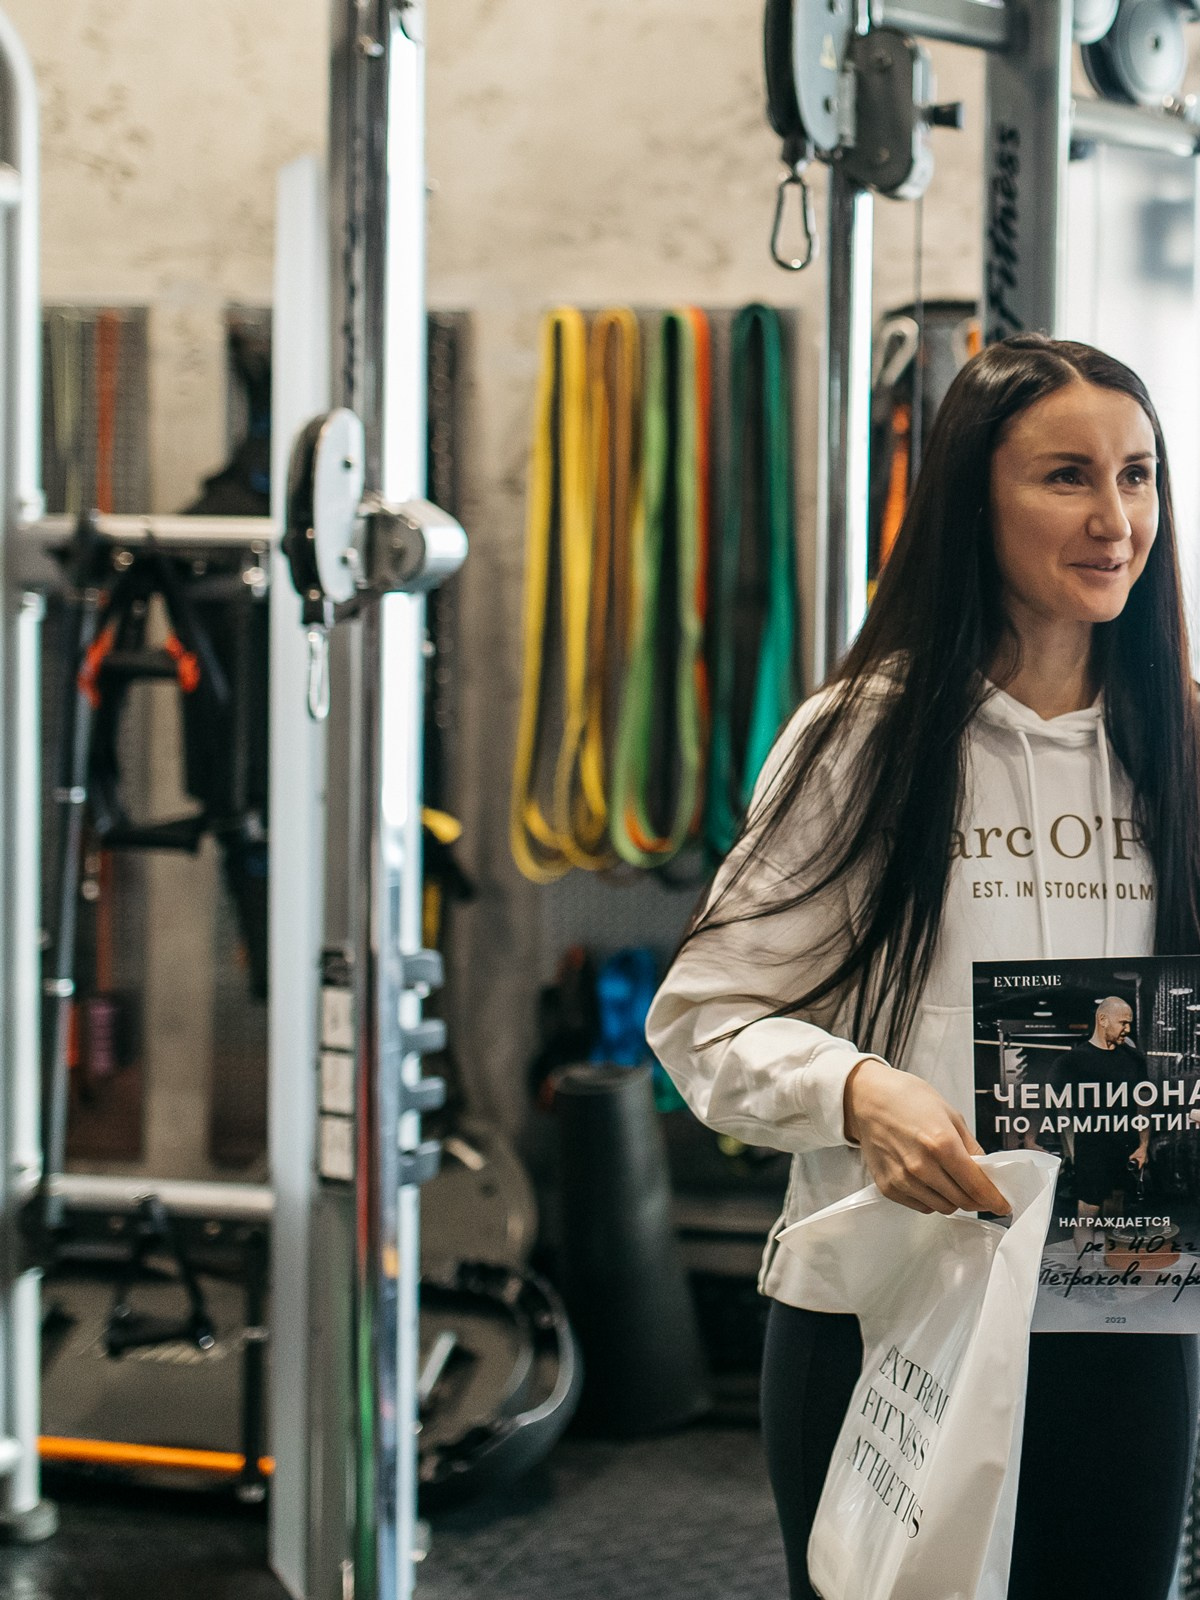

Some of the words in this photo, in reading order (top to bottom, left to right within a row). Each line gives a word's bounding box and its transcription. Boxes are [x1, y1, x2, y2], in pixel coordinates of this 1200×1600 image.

[948, 826, 1034, 860] arc
[1050, 814, 1144, 860] O’P
[973, 881, 1009, 899] EST.
[1016, 881, 1034, 898] IN
[993, 974, 1062, 988] EXTREME
[995, 1116, 1031, 1134] ПО
[1059, 1216, 1171, 1229] НАГРАЖДАЕТСЯ
[1105, 1316, 1127, 1325] 2023
[878, 1344, 950, 1428] EXTREM
[859, 1384, 930, 1471] FITNESS
